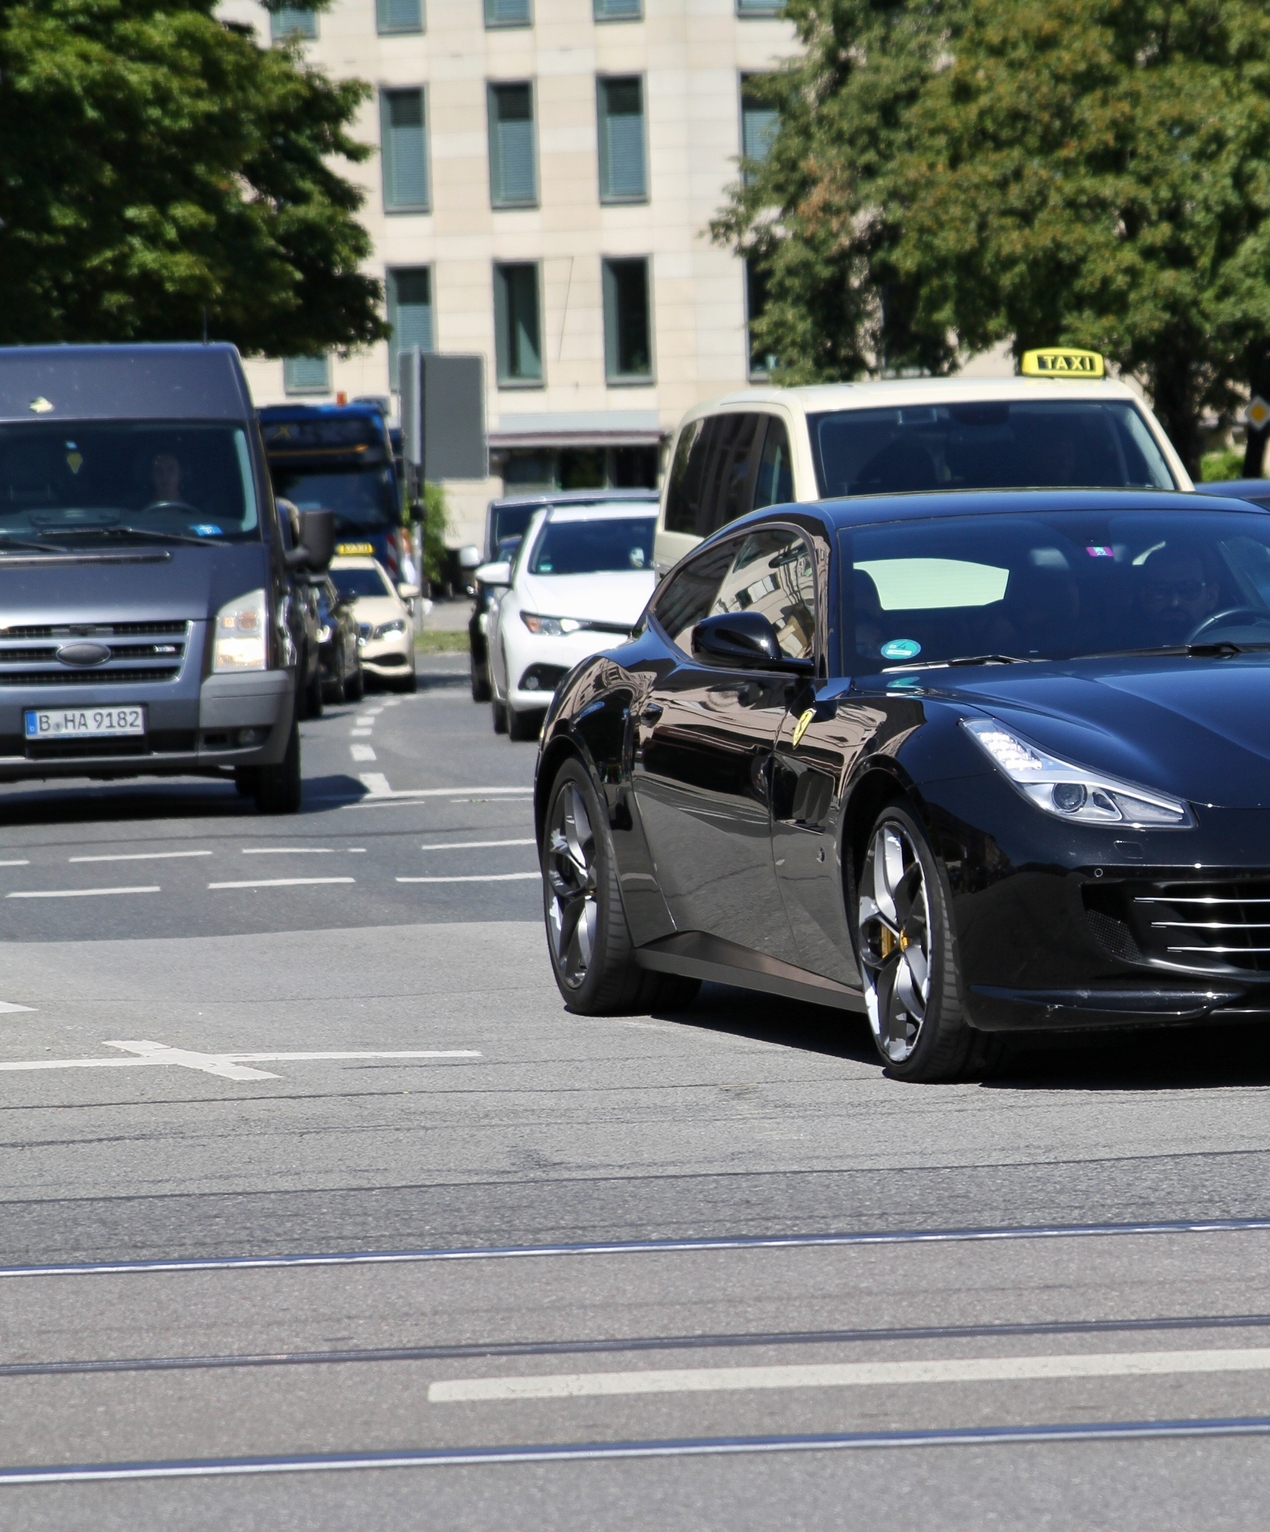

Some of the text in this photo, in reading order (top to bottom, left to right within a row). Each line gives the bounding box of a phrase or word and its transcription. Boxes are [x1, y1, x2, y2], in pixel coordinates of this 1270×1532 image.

[1043, 356, 1091, 370] TAXI
[345, 544, 368, 553] TAXI
[39, 714, 51, 732] B
[63, 712, 89, 730] HA
[93, 710, 140, 729] 9182
